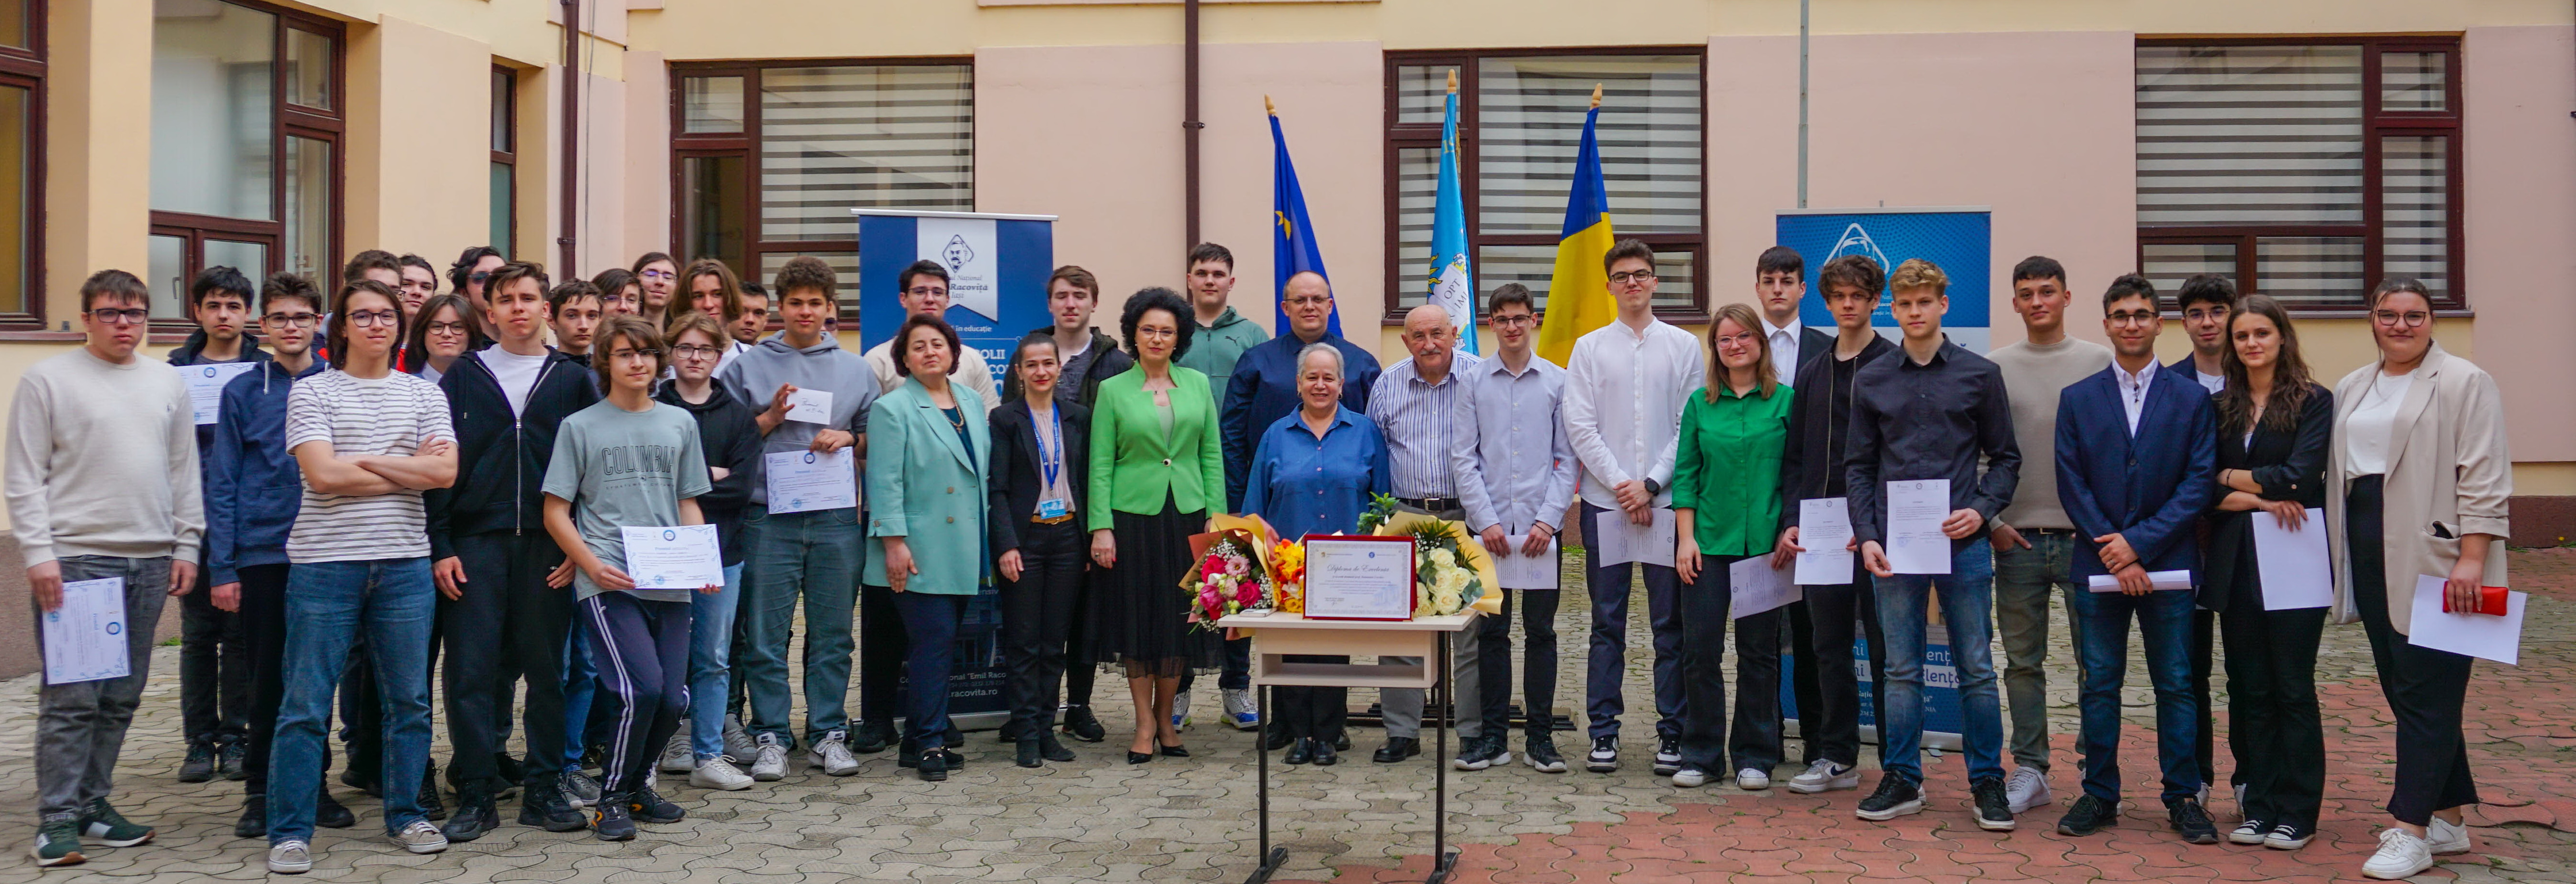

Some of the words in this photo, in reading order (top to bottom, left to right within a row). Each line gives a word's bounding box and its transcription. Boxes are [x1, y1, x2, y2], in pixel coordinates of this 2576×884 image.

[950, 283, 988, 293] Racoviță
[1444, 278, 1460, 299] OPT
[601, 445, 675, 476] COLUMBIA
